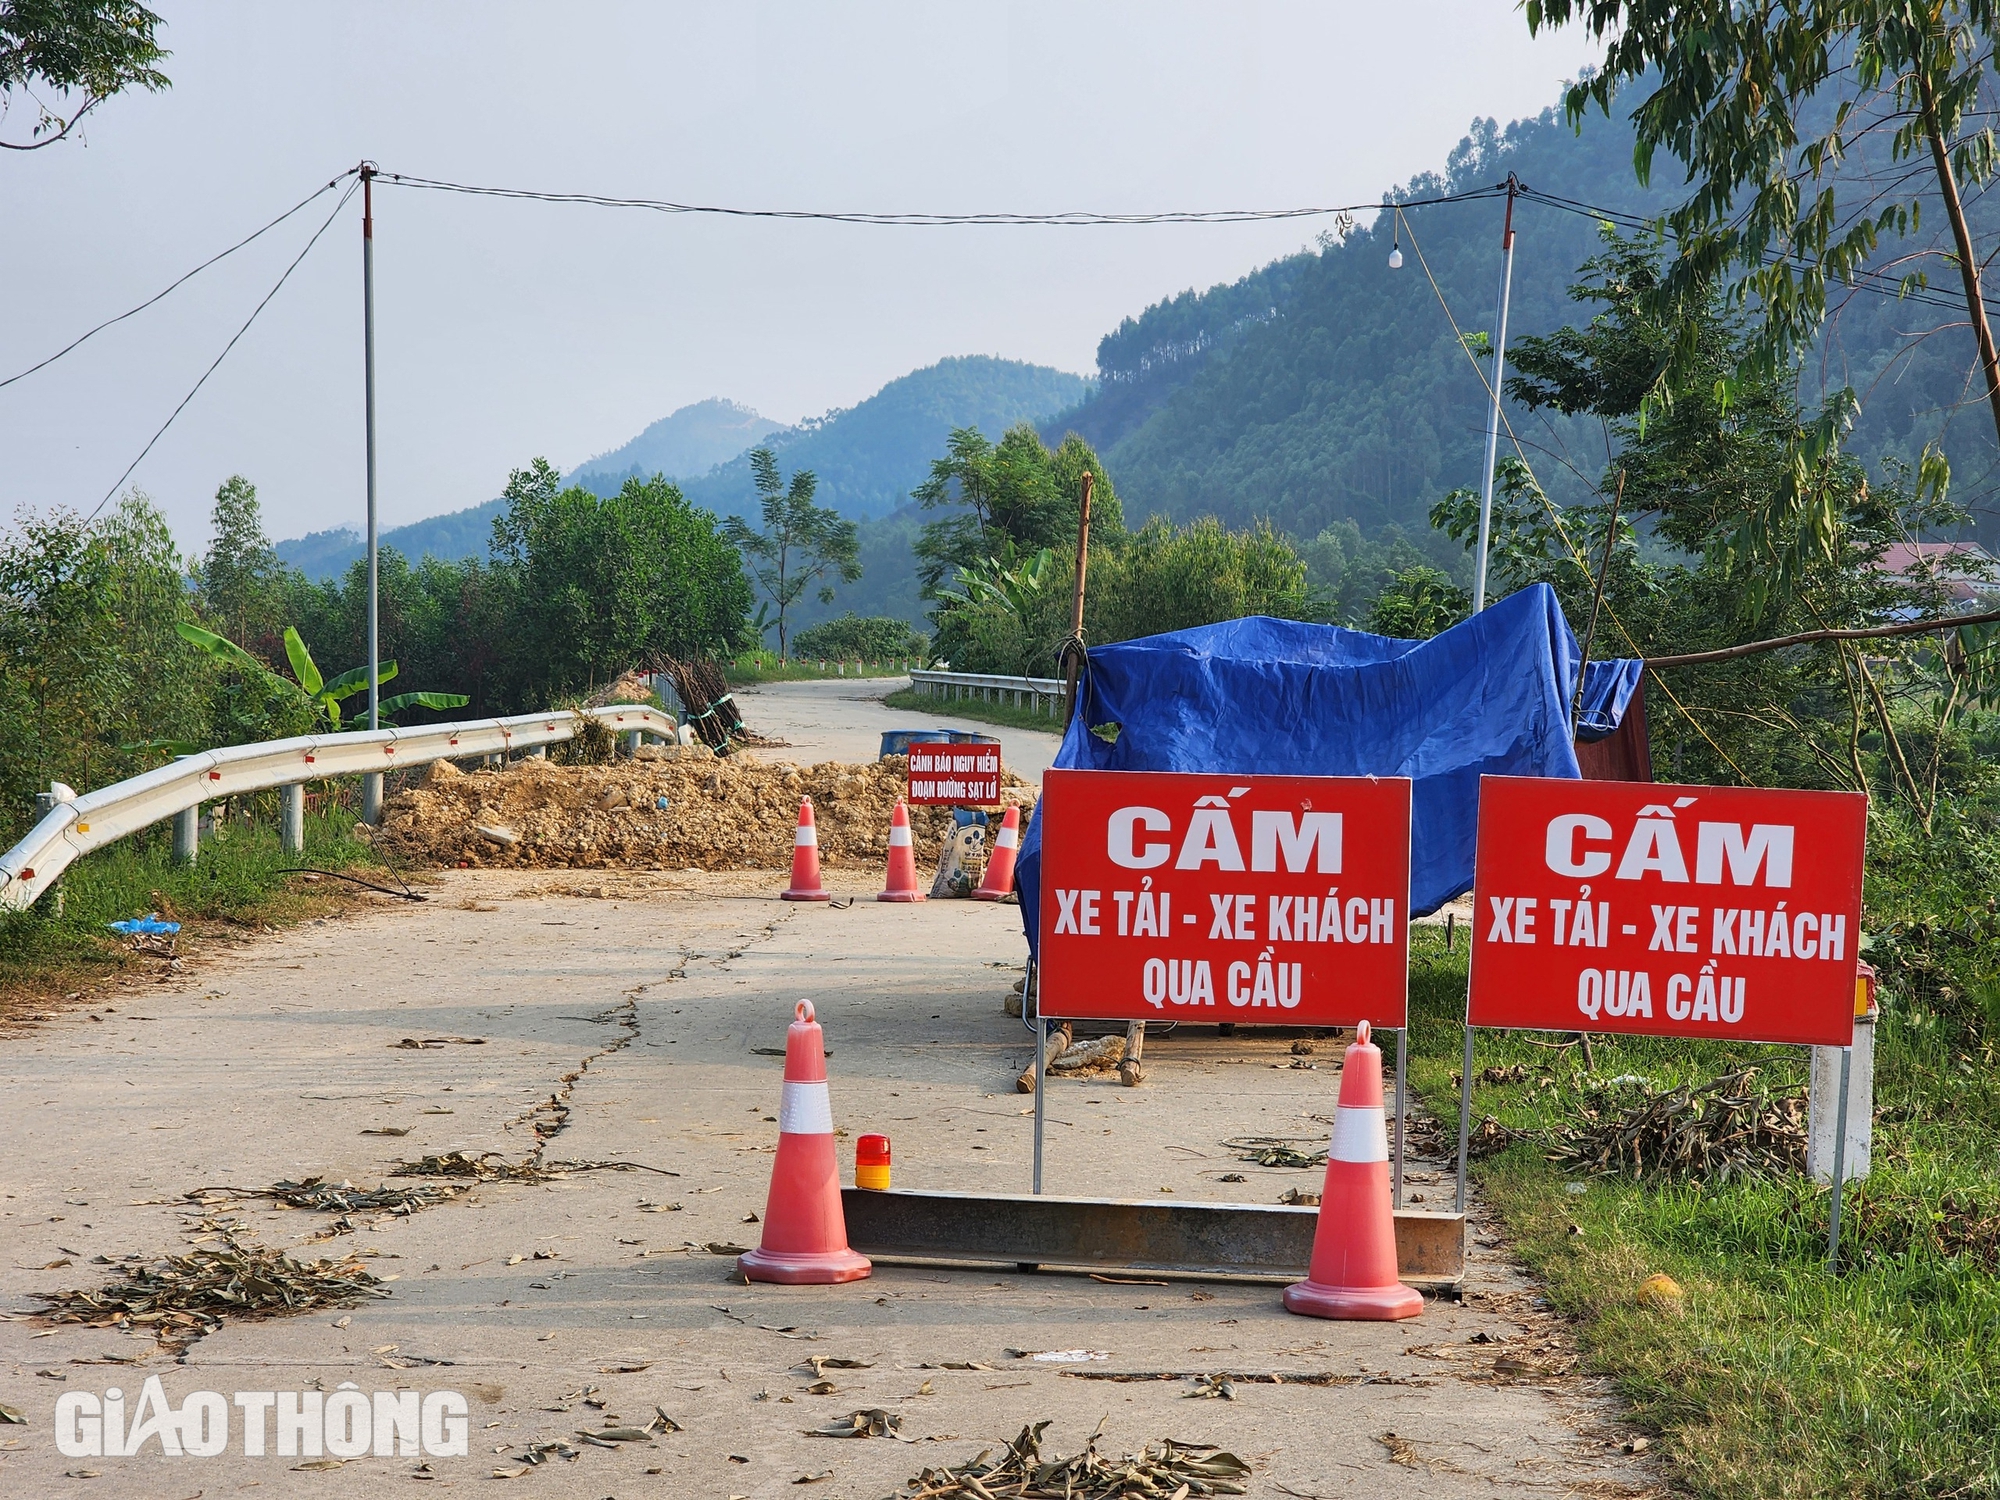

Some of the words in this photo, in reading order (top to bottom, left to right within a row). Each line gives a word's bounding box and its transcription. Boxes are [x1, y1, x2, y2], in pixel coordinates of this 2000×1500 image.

[910, 749, 932, 773] CẢNH
[934, 752, 951, 773] BÁO
[953, 755, 975, 773] NGUY
[976, 748, 998, 773] HIỂM
[911, 780, 936, 801] ĐOẠN
[937, 776, 966, 799] ĐƯỜNG
[967, 781, 984, 801] SẠT
[985, 775, 997, 799] LỞ
[1107, 787, 1343, 874] CẤM
[1545, 797, 1795, 889] CẤM
[1054, 889, 1101, 936] XE
[1112, 875, 1170, 938] TẢI
[1183, 914, 1197, 924] -
[1208, 894, 1256, 941] XE
[1268, 887, 1394, 944] KHÁCH
[1487, 896, 1537, 945] XE
[1550, 884, 1609, 948] TẢI
[1622, 924, 1636, 935] -
[1648, 904, 1699, 954] XE
[1712, 901, 1846, 961] KHÁCH
[1143, 957, 1215, 1009] QUA
[1227, 945, 1302, 1009] CẦU
[1577, 968, 1653, 1021] QUA
[1666, 958, 1746, 1024] CẦU
